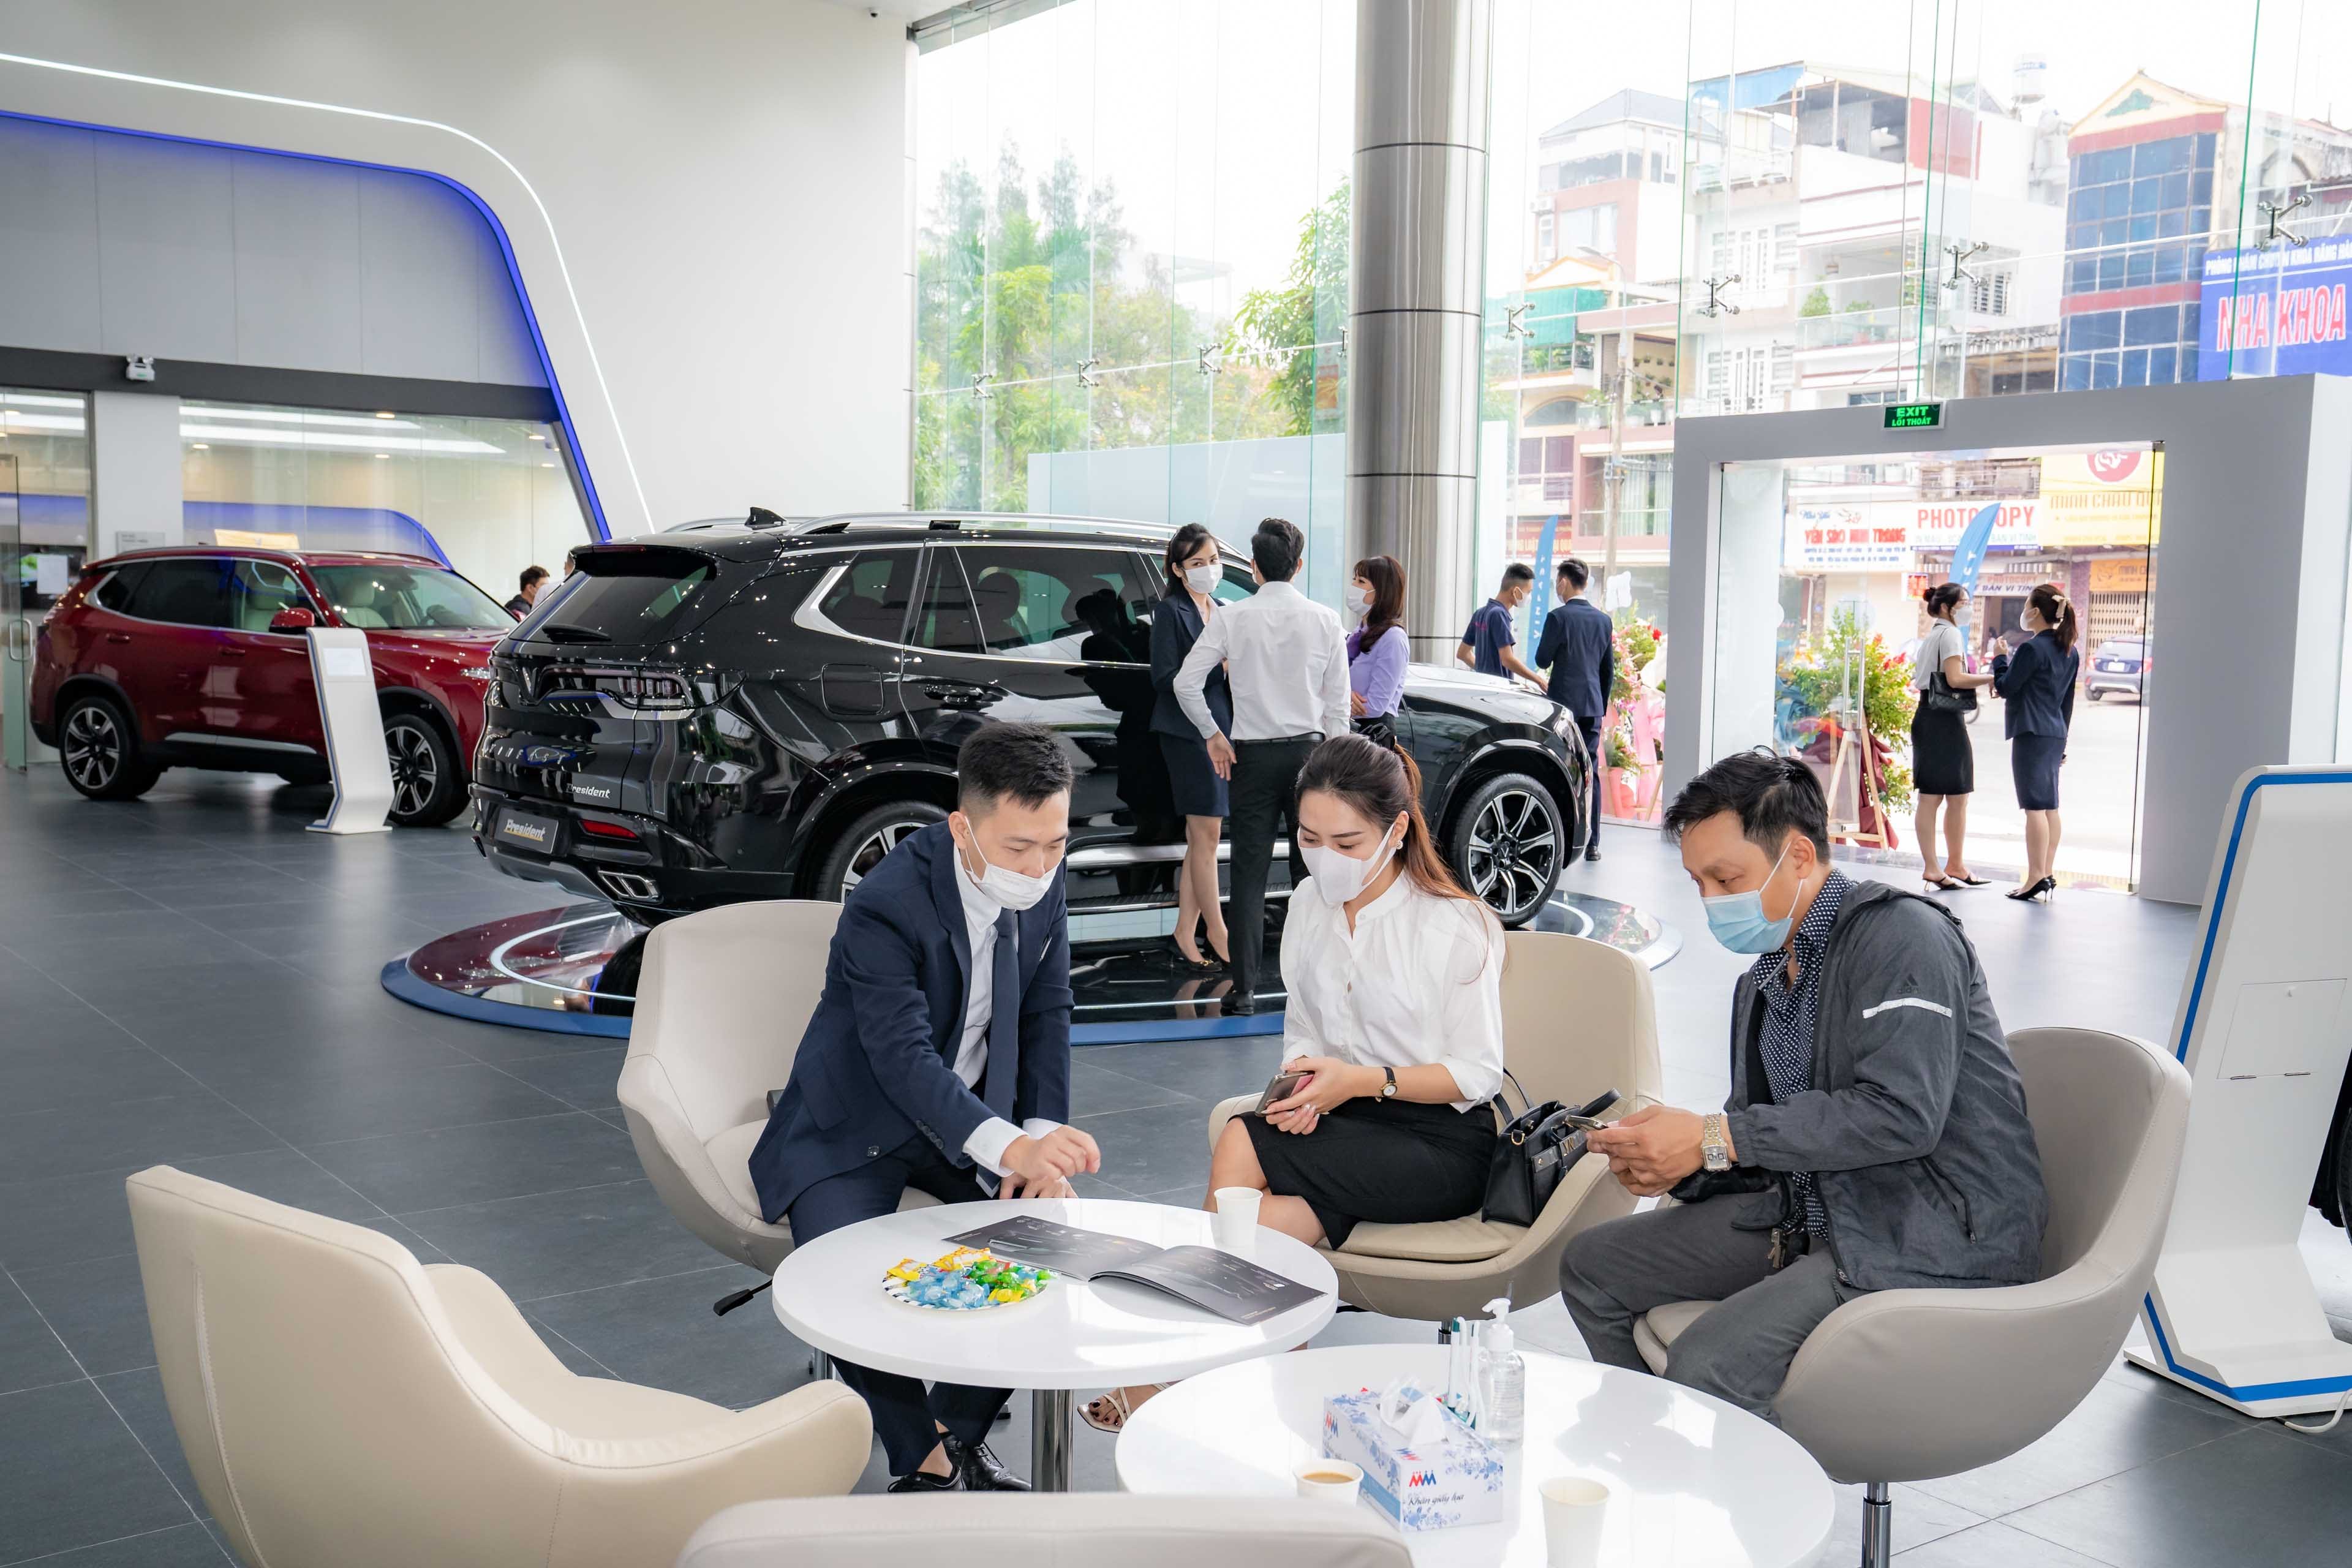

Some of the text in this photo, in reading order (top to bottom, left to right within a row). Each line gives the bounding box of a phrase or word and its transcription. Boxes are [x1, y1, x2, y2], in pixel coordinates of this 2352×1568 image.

[2217, 283, 2346, 352] NHA KHOA
[1896, 405, 1929, 417] EXIT
[1891, 417, 1932, 427] LỐI THOÁT
[489, 743, 567, 765] VINFAST
[565, 783, 611, 799] President
[504, 818, 547, 840] President
